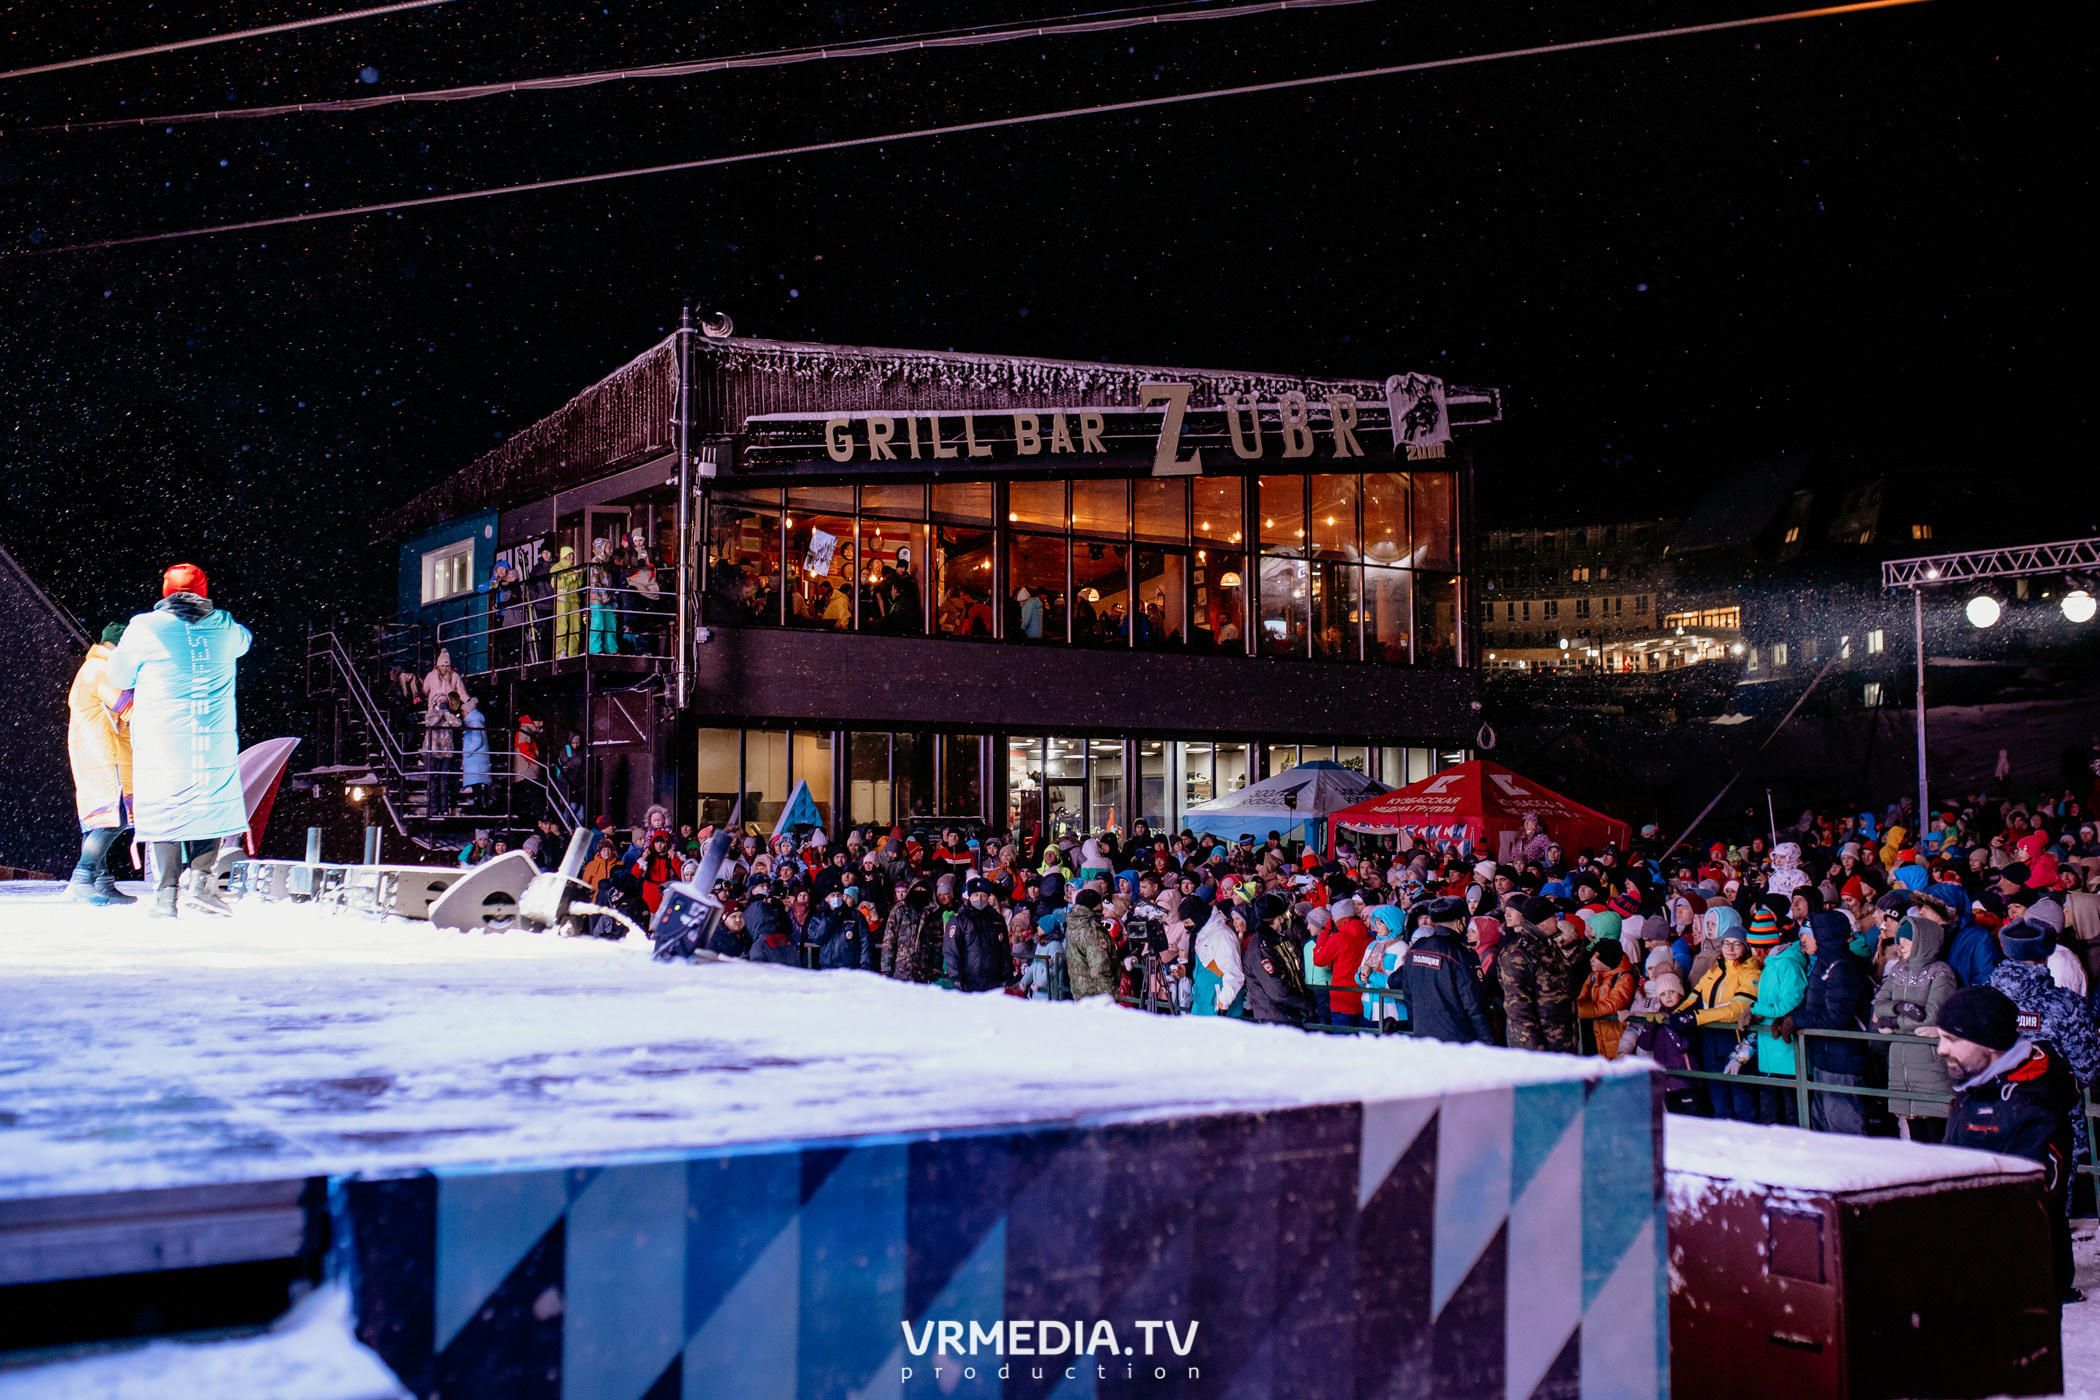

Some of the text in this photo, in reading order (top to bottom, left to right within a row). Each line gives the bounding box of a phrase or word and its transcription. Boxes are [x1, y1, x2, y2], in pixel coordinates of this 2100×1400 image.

[825, 383, 1365, 476] GRILL BAR ZUBR
[1387, 797, 1462, 805] КУЗБАССКАЯ
[1413, 954, 1440, 966] ПОЛИЦИЯ
